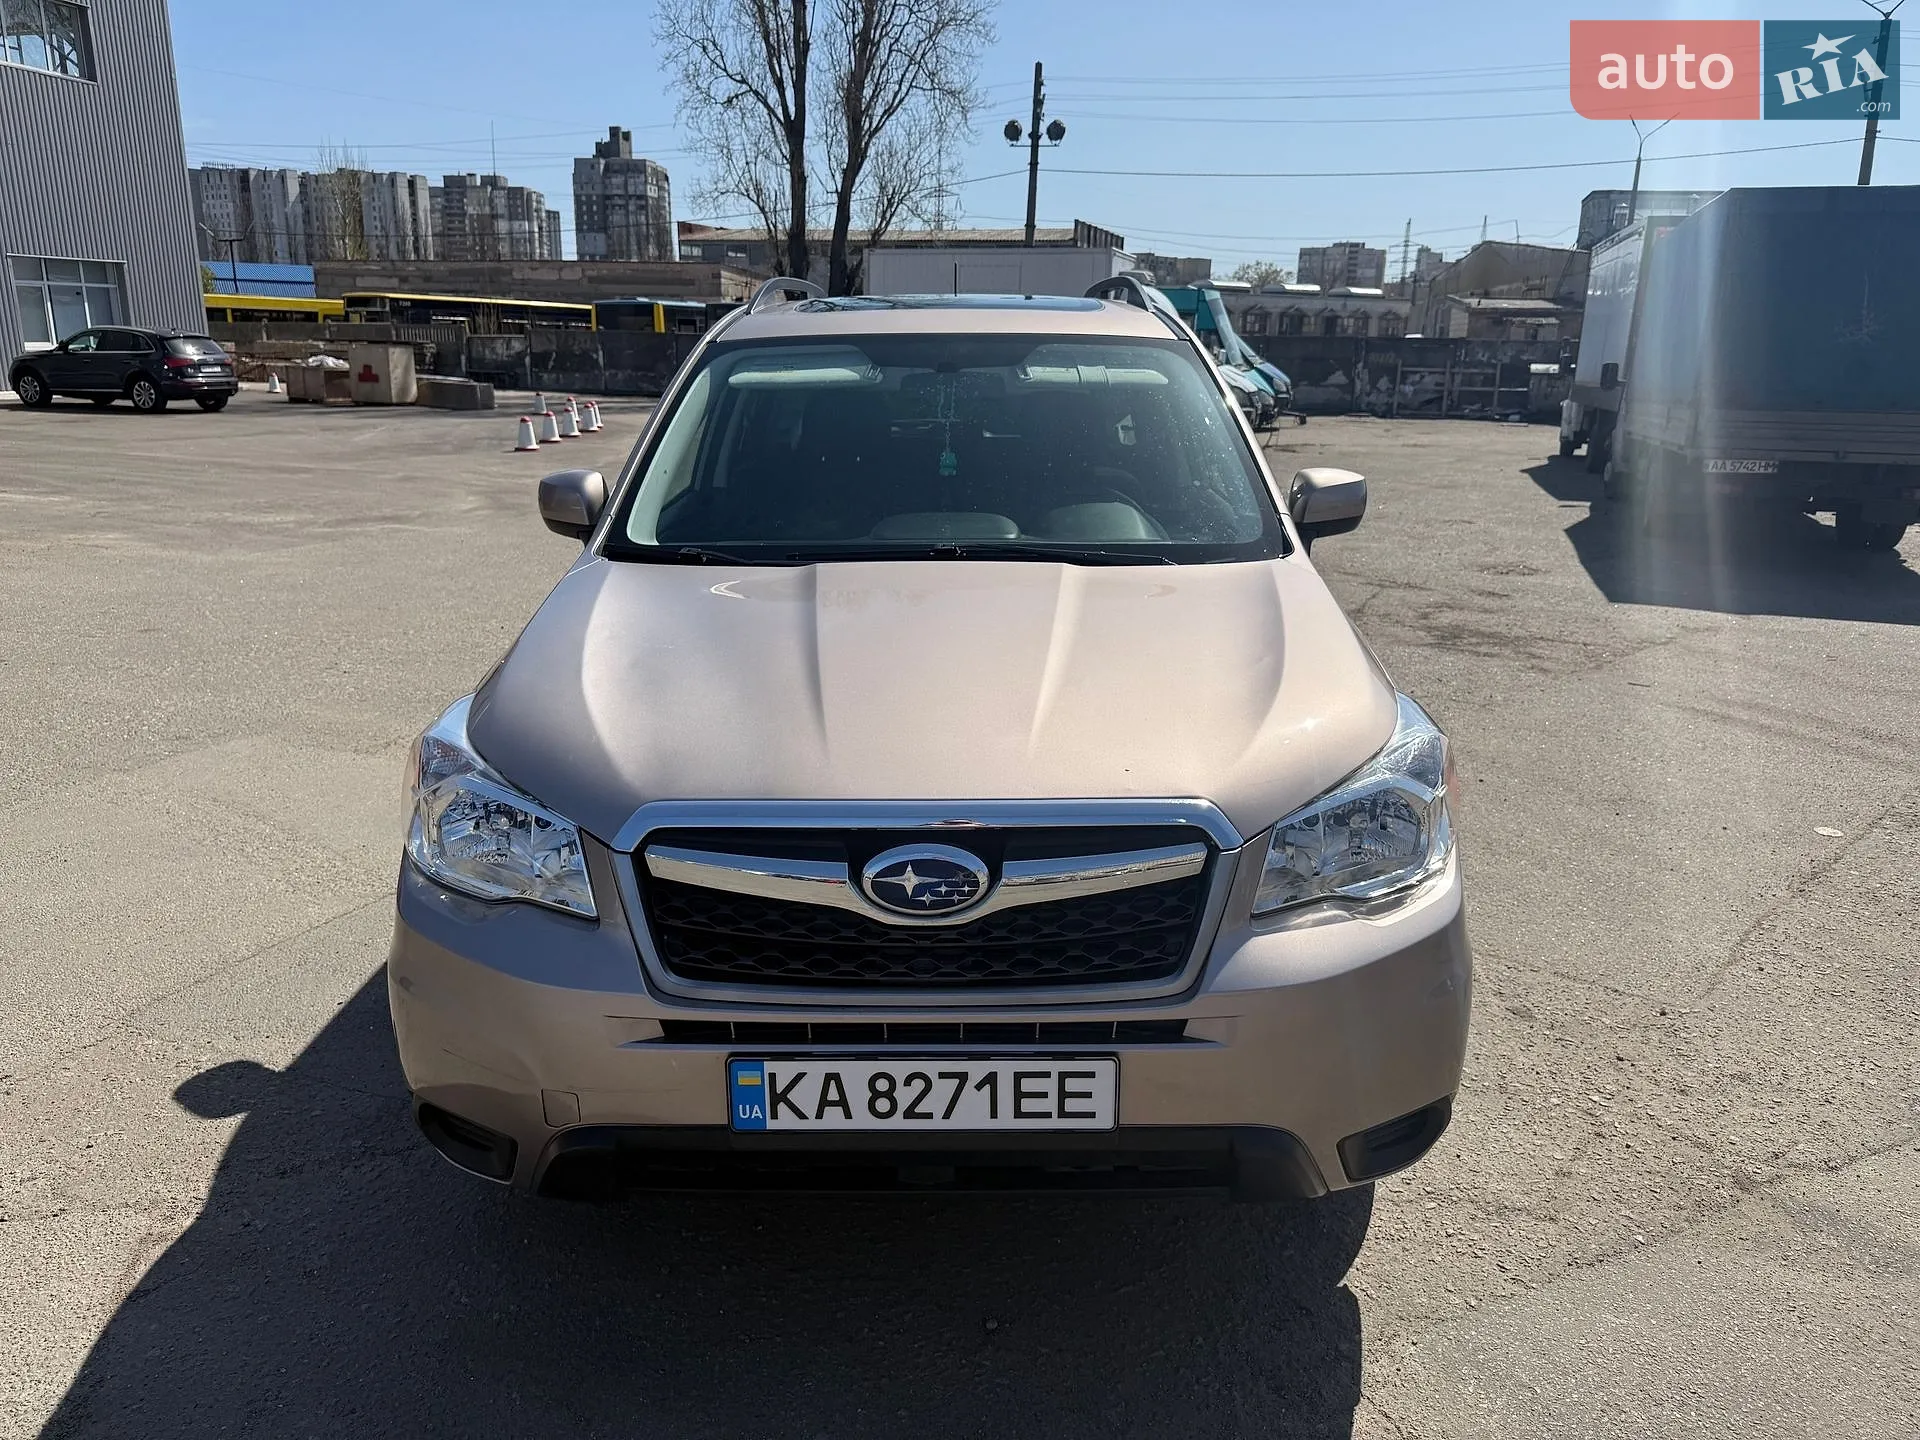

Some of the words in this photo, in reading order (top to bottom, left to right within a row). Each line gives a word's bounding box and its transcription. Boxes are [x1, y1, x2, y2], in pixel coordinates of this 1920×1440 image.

[1711, 461, 1727, 471] AA
[1729, 461, 1757, 472] 5742
[767, 1072, 853, 1120] KA
[867, 1071, 999, 1120] 8271
[1013, 1071, 1098, 1119] EE
[738, 1104, 763, 1119] UA
